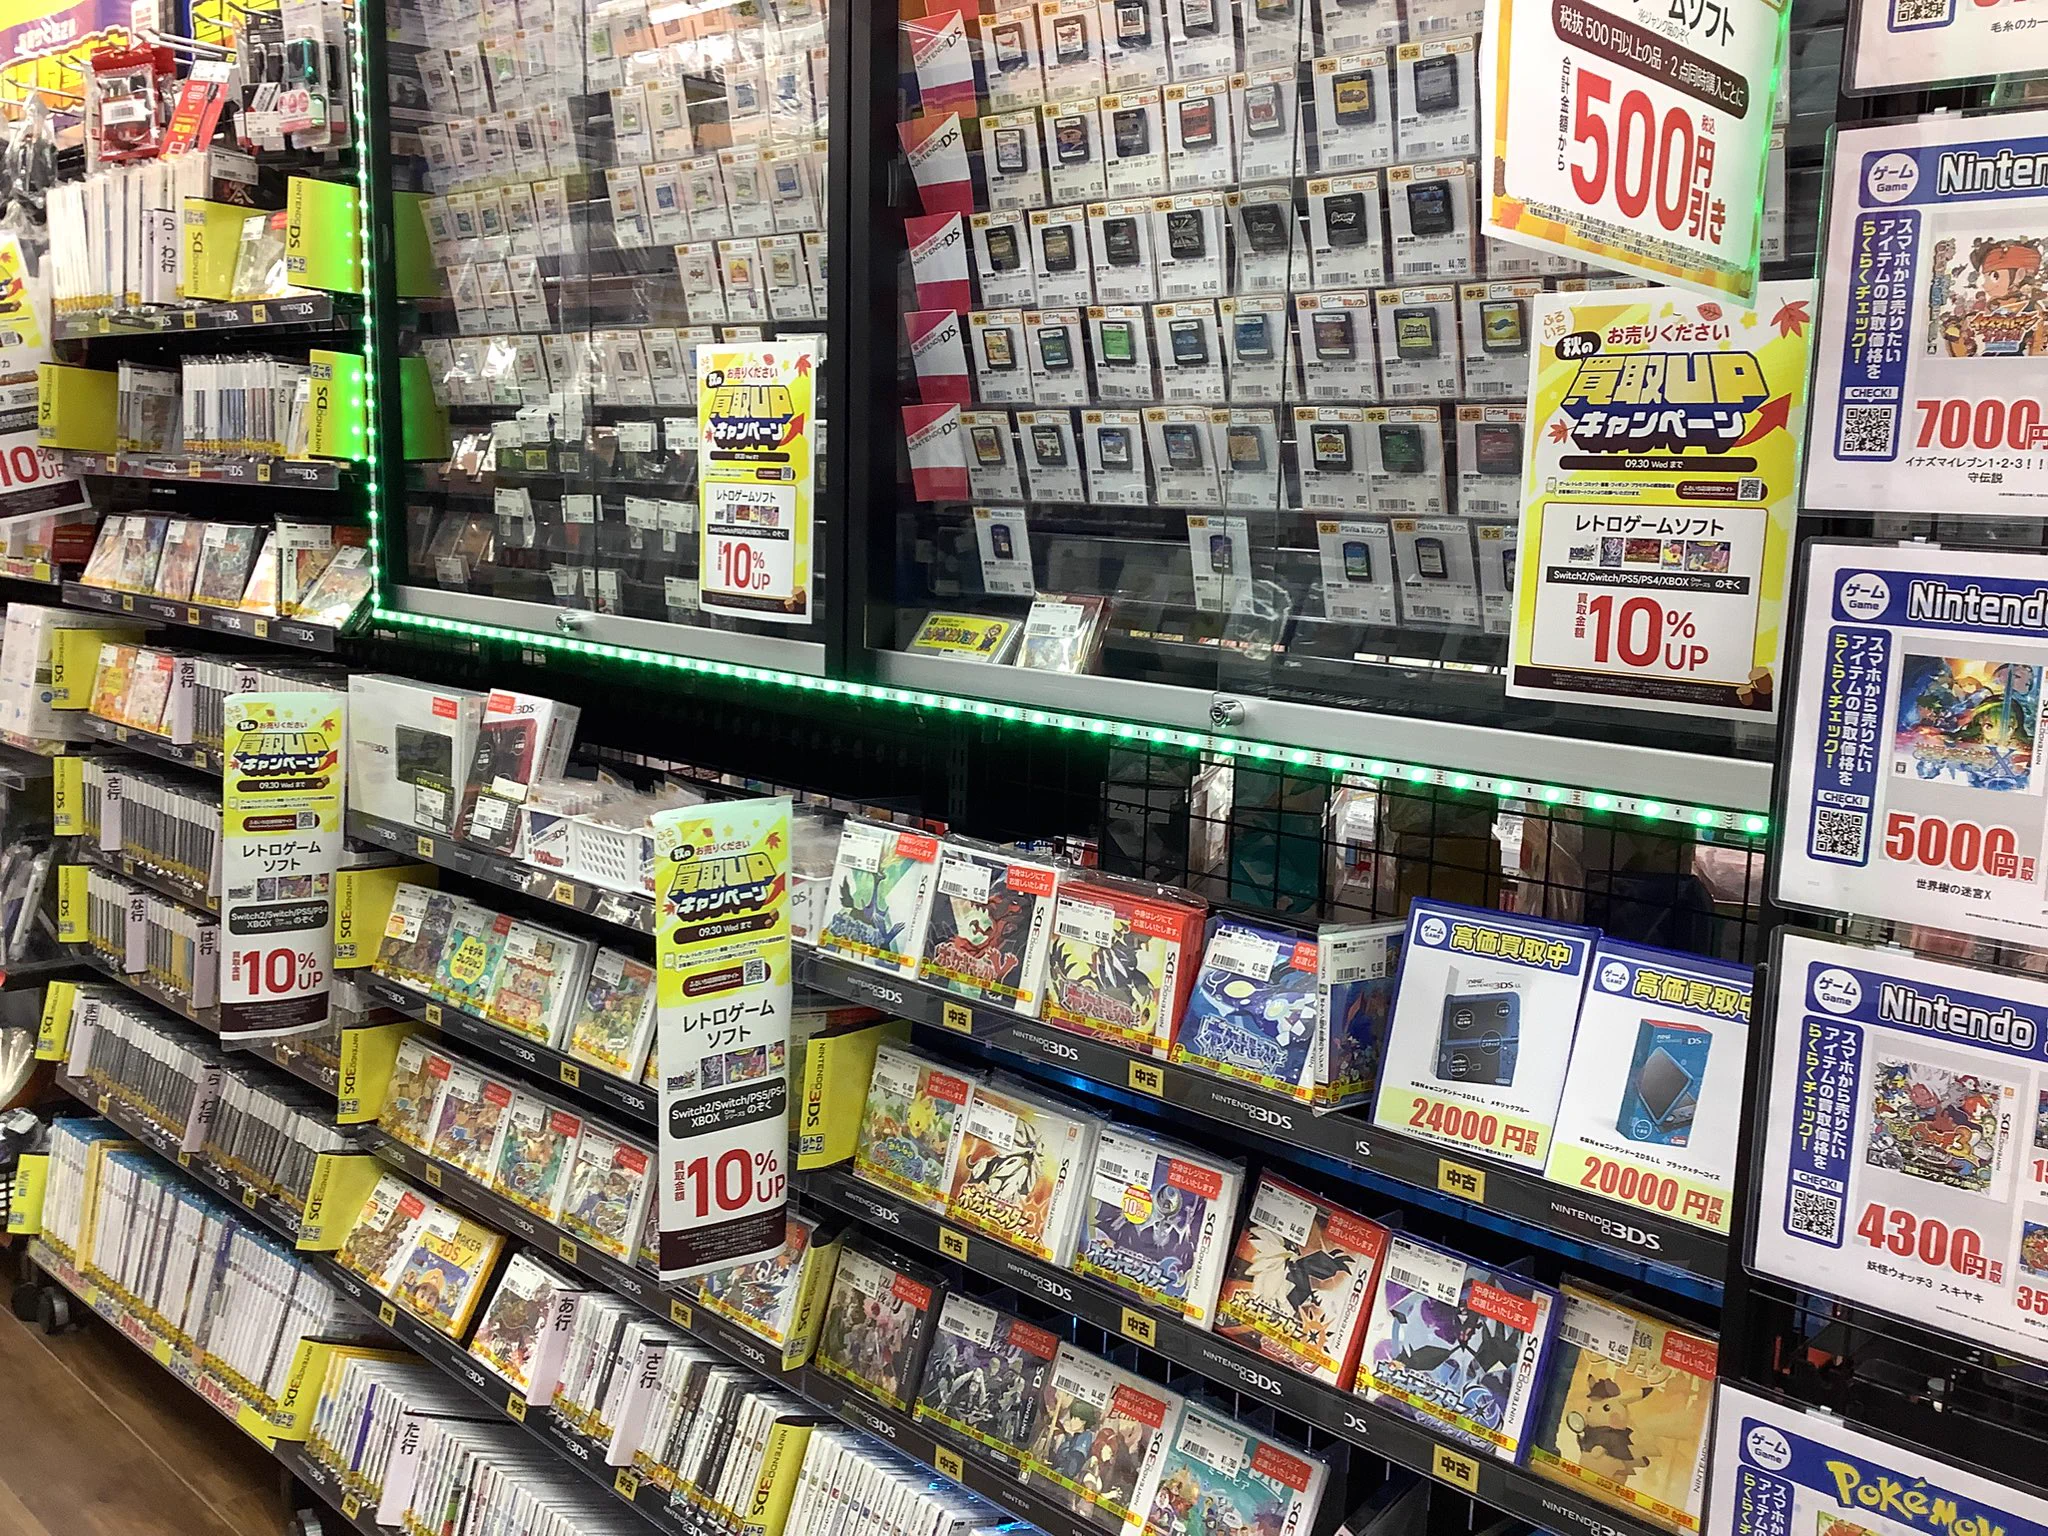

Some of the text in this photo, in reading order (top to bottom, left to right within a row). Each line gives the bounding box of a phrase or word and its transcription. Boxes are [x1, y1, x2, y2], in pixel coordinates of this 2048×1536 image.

[1556, 55, 1571, 171] 合計金額から
[941, 128, 960, 147] DS
[1570, 67, 1695, 232] 500
[1872, 162, 1915, 181] ゲーム
[1876, 181, 1909, 192] Game
[289, 223, 301, 249] DS
[1866, 219, 1895, 380] アイテムの買取価格を
[1886, 218, 1913, 363] スマホから売りたい
[1562, 337, 1594, 356] 秋の
[1606, 324, 1730, 345] お売りください
[727, 368, 778, 379] お売りください
[317, 386, 329, 411] DS
[715, 422, 782, 441] キャンペーン
[1574, 410, 1744, 439] キャンペーン
[1916, 399, 2040, 450] 7000
[1624, 458, 1684, 469] 09.30 Wed まで
[1968, 472, 2003, 483] 守伝説
[716, 490, 776, 503] レトロゲームソフト
[1575, 514, 1724, 537] レトロゲームソフト
[722, 542, 751, 588] 10
[1714, 580, 1741, 590] のぞく
[1845, 583, 1885, 599] ゲーム
[1574, 592, 1588, 639] 買取金額
[1849, 600, 1880, 611] Game
[1589, 594, 1664, 667] 10
[1664, 644, 1709, 671] UP
[181, 662, 195, 689] あ行
[1838, 634, 1868, 786] アイテムの買取価格を
[1856, 637, 1885, 774] スマホから売りたい
[242, 756, 320, 771] キャンペーン
[106, 776, 122, 800] さ行
[1823, 792, 1864, 805] CHECK!
[242, 841, 321, 858] レトロゲーム
[696, 840, 750, 855] お売りください
[1886, 812, 2016, 876] 5000
[264, 858, 301, 872] ソフト
[131, 898, 145, 923] な行
[678, 885, 768, 914] キャンペーン
[199, 929, 214, 956] は行
[699, 926, 722, 938] 09.30
[723, 923, 739, 933] Wed
[1451, 924, 1572, 967] 高価買取中
[242, 948, 296, 995] 10
[298, 971, 323, 990] UP
[1818, 975, 1858, 997] ゲーム
[1821, 993, 1853, 1007] Game
[683, 998, 775, 1032] レトロゲーム
[948, 1009, 967, 1026] 中古
[1880, 984, 2036, 1049] Nintendo
[707, 1025, 751, 1048] ソフト
[1048, 1038, 1079, 1062] 3DS
[1134, 1068, 1158, 1089] 中古
[1813, 1026, 1841, 1170] アイテムの買取価格を
[1831, 1029, 1858, 1161] スマホから売りたい
[691, 1099, 772, 1128] XBOX のぞく
[807, 1089, 822, 1128] 3DS
[1256, 1108, 1294, 1130] 3DS
[1409, 1097, 1498, 1146] 24000
[687, 1148, 754, 1218] 10
[756, 1173, 786, 1203] UP
[1445, 1167, 1477, 1192] 中古
[1580, 1156, 1679, 1212] 20000
[1798, 1172, 1840, 1191] CHECK!
[874, 1204, 900, 1224] 3DS
[457, 1230, 483, 1254] MAKER
[943, 1232, 964, 1256] 中古
[1611, 1222, 1660, 1250] 3DS
[1856, 1201, 1981, 1275] 4300
[436, 1239, 461, 1261] 3DS
[1043, 1277, 1073, 1302] 3DS
[1939, 1283, 1984, 1304] スキヤキ
[555, 1297, 575, 1331] あ行
[1126, 1314, 1152, 1338] 中古
[640, 1353, 663, 1389] さ行
[1032, 1366, 1044, 1389] DS
[1246, 1369, 1284, 1396] 3DS
[401, 1422, 421, 1455] た行
[870, 1415, 896, 1439] 3DS
[1751, 1432, 1787, 1457] ゲーム
[938, 1454, 959, 1476] 中古
[1440, 1455, 1471, 1478] 中古
[617, 1476, 634, 1496] 中古
